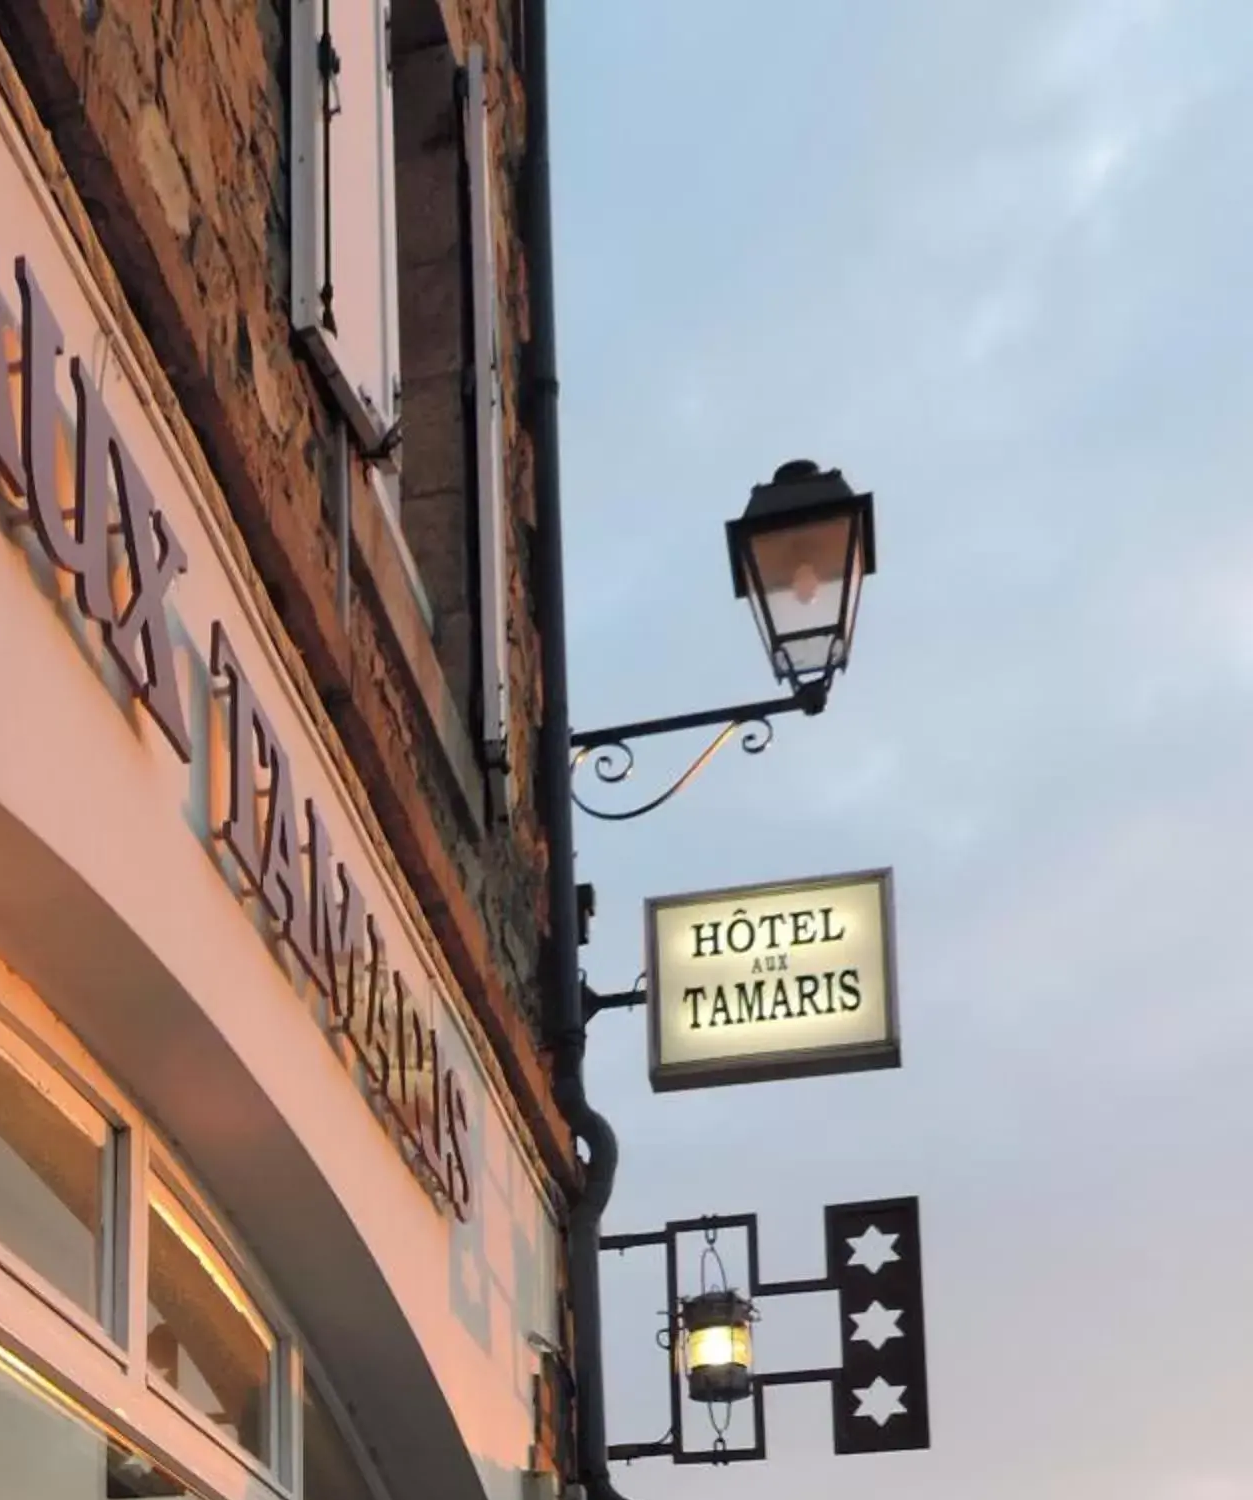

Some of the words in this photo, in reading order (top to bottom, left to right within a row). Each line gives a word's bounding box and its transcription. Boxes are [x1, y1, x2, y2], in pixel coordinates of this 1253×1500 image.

[209, 620, 472, 1224] TAMARIS
[691, 908, 845, 957] HÔTEL
[751, 953, 788, 974] AUX
[683, 968, 861, 1029] TAMARIS
